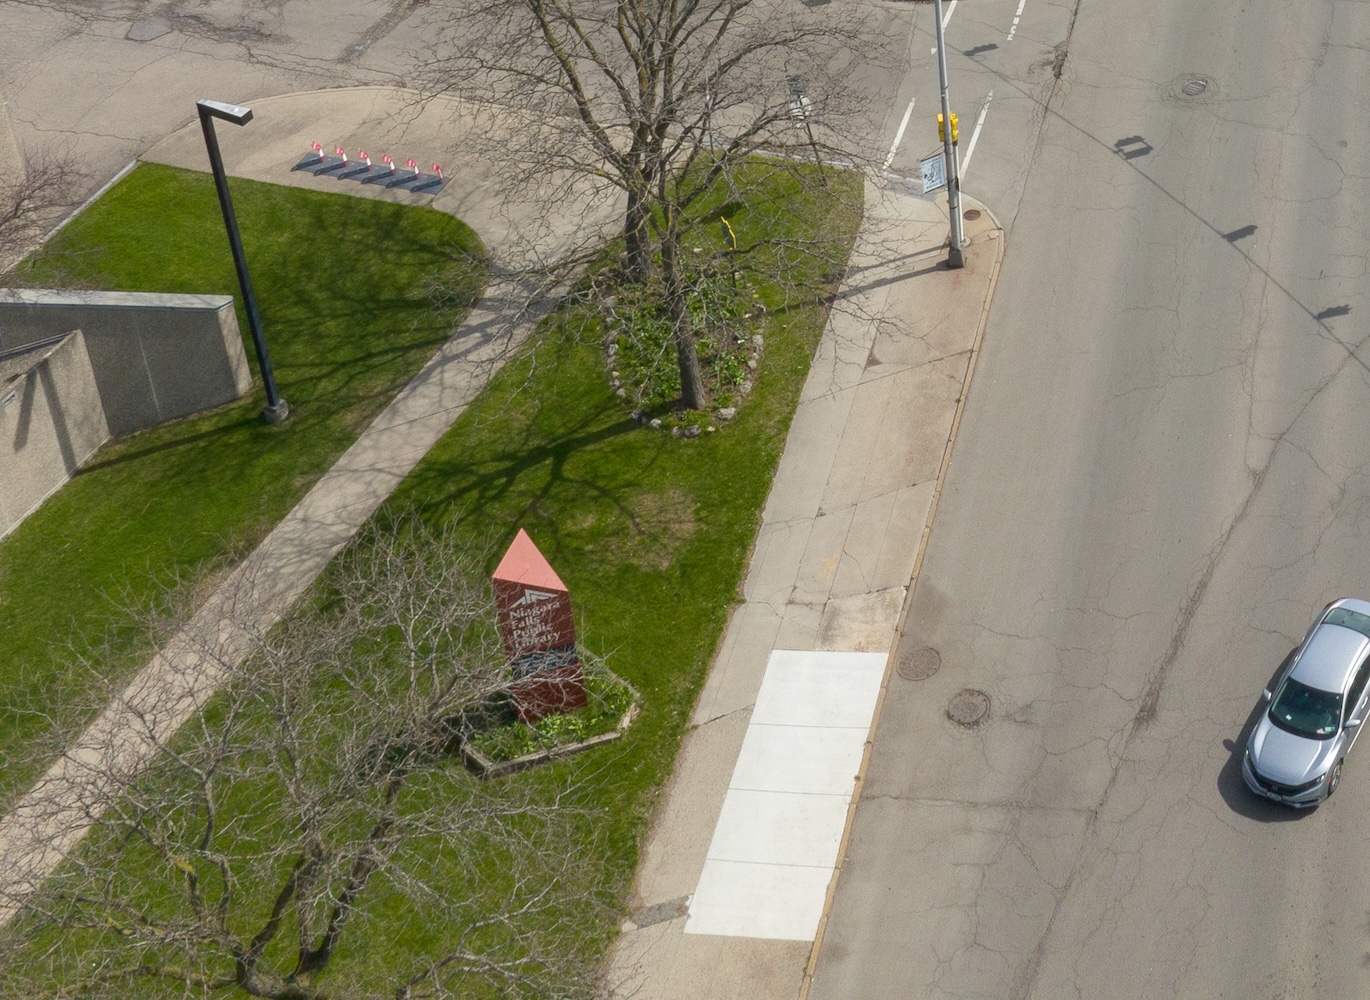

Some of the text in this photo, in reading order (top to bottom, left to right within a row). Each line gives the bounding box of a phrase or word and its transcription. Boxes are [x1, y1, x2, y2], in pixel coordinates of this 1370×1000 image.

[510, 602, 560, 619] Niagara
[511, 616, 540, 630] Falls
[513, 623, 553, 639] Public
